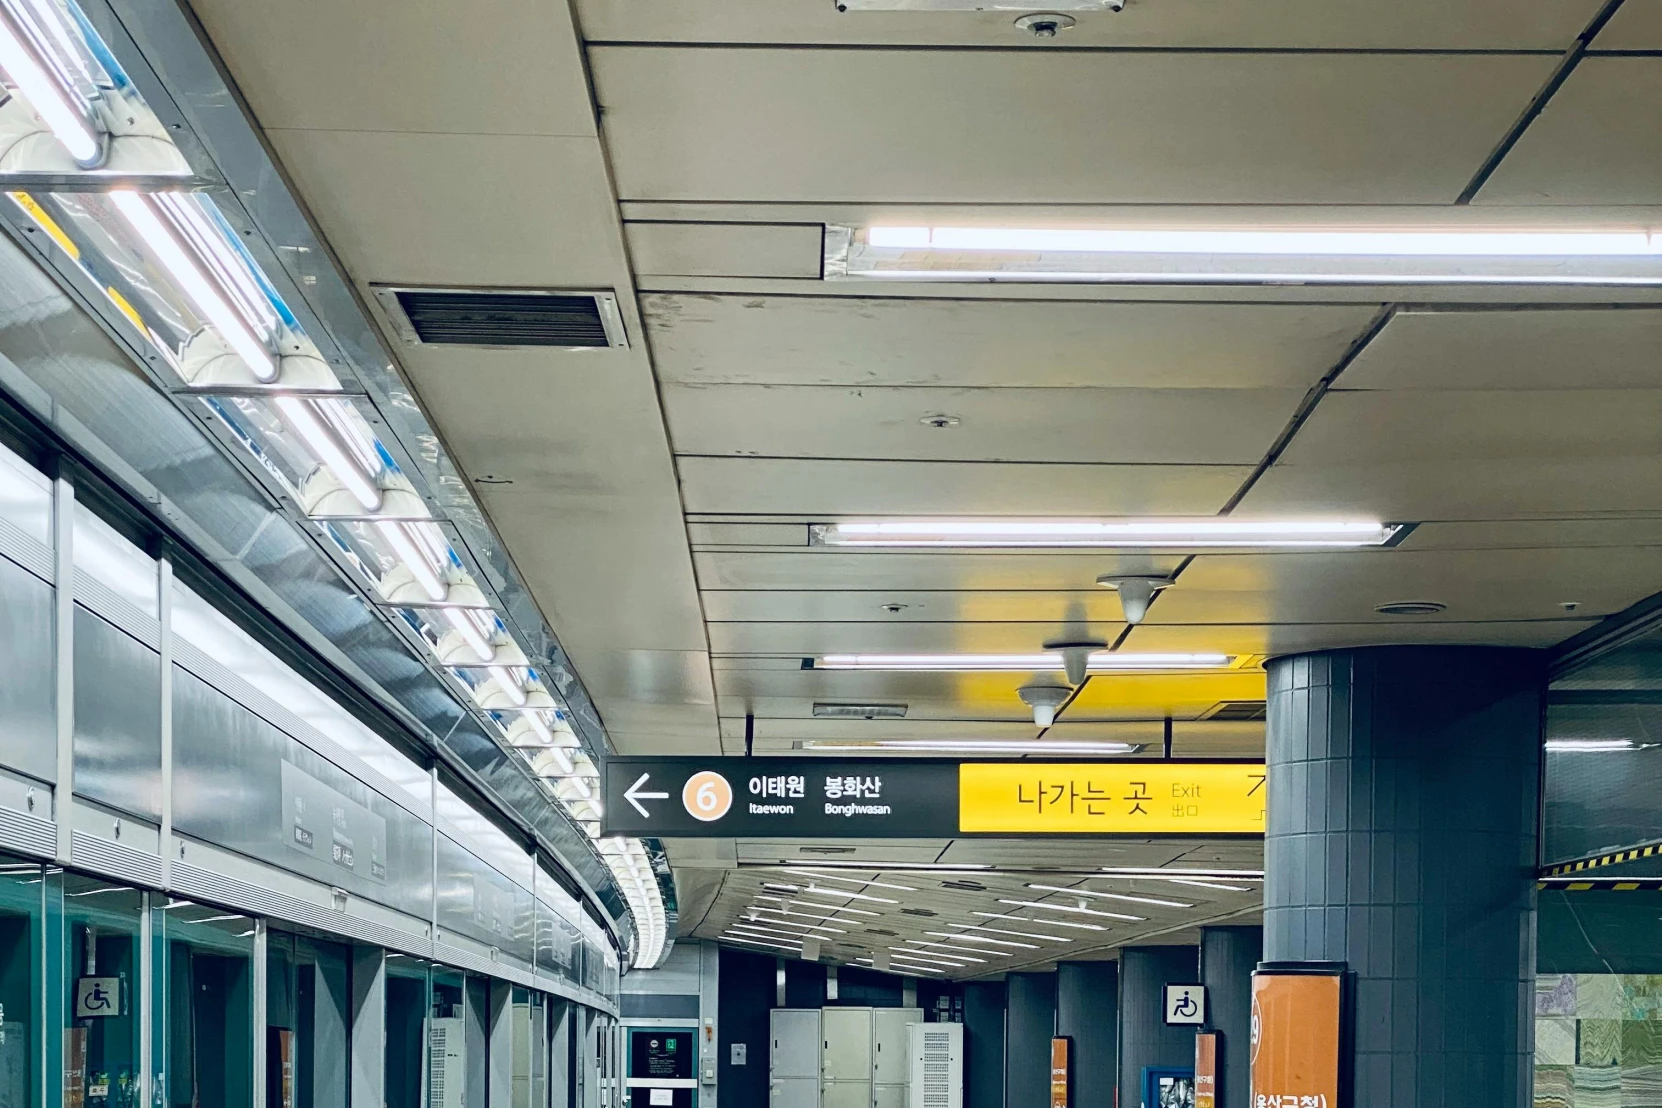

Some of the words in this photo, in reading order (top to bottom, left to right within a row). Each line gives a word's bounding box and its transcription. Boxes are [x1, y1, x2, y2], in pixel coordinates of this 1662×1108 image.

[696, 781, 717, 811] 6
[748, 775, 805, 798] 이태원
[824, 775, 882, 798] 봉화산
[1171, 782, 1202, 798] Exit
[1018, 780, 1111, 815] 나가는
[1123, 781, 1153, 815] 곳
[749, 802, 794, 814] Itaewon
[824, 802, 891, 817] Bonghwasan
[1172, 804, 1199, 818] 出口
